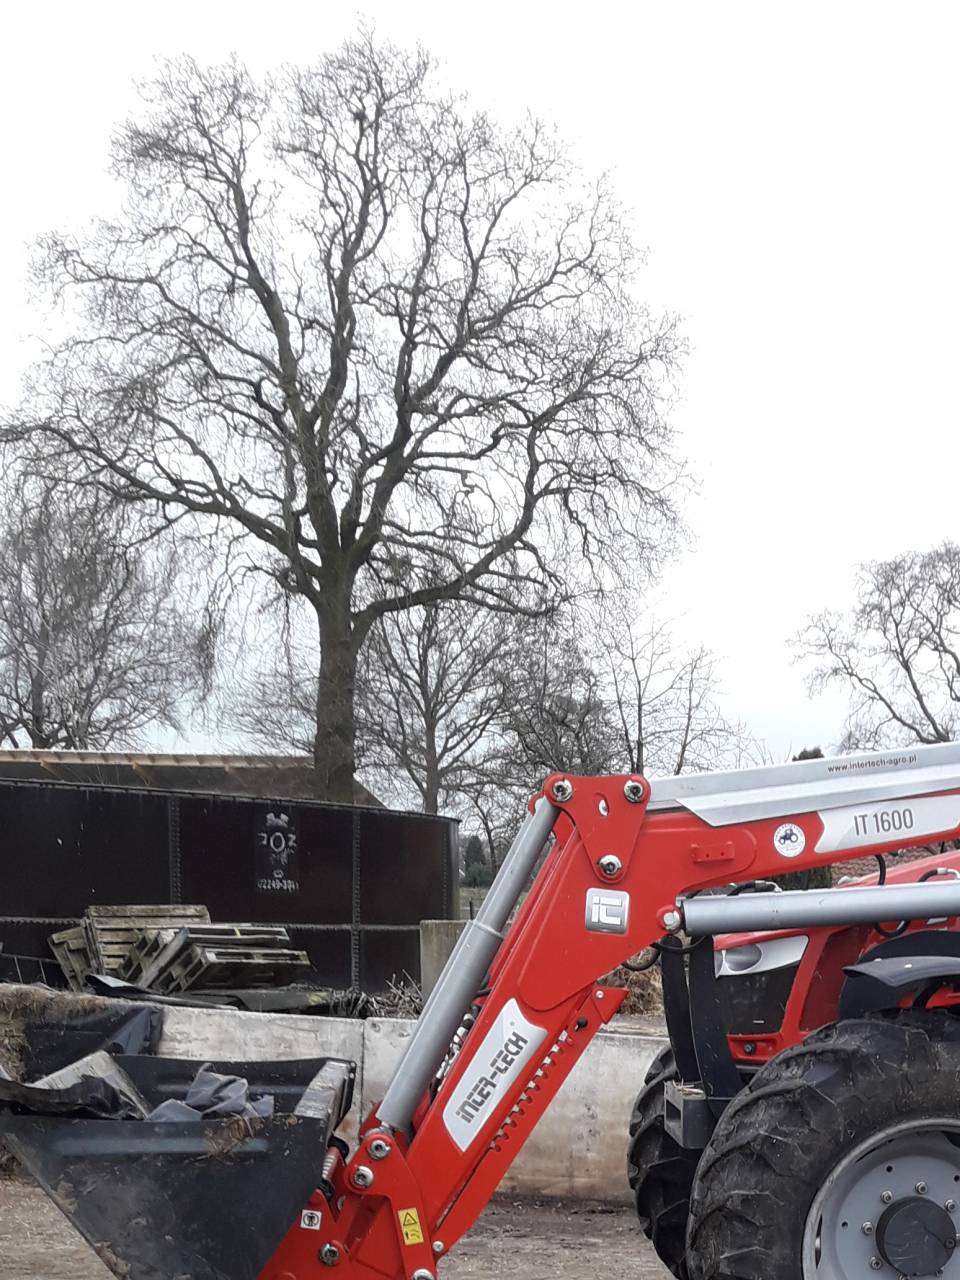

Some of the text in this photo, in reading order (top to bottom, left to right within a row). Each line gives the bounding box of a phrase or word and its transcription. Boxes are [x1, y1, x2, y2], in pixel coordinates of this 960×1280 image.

[827, 754, 917, 773] www.intertech-agro.pl
[854, 808, 914, 836] IT 1600
